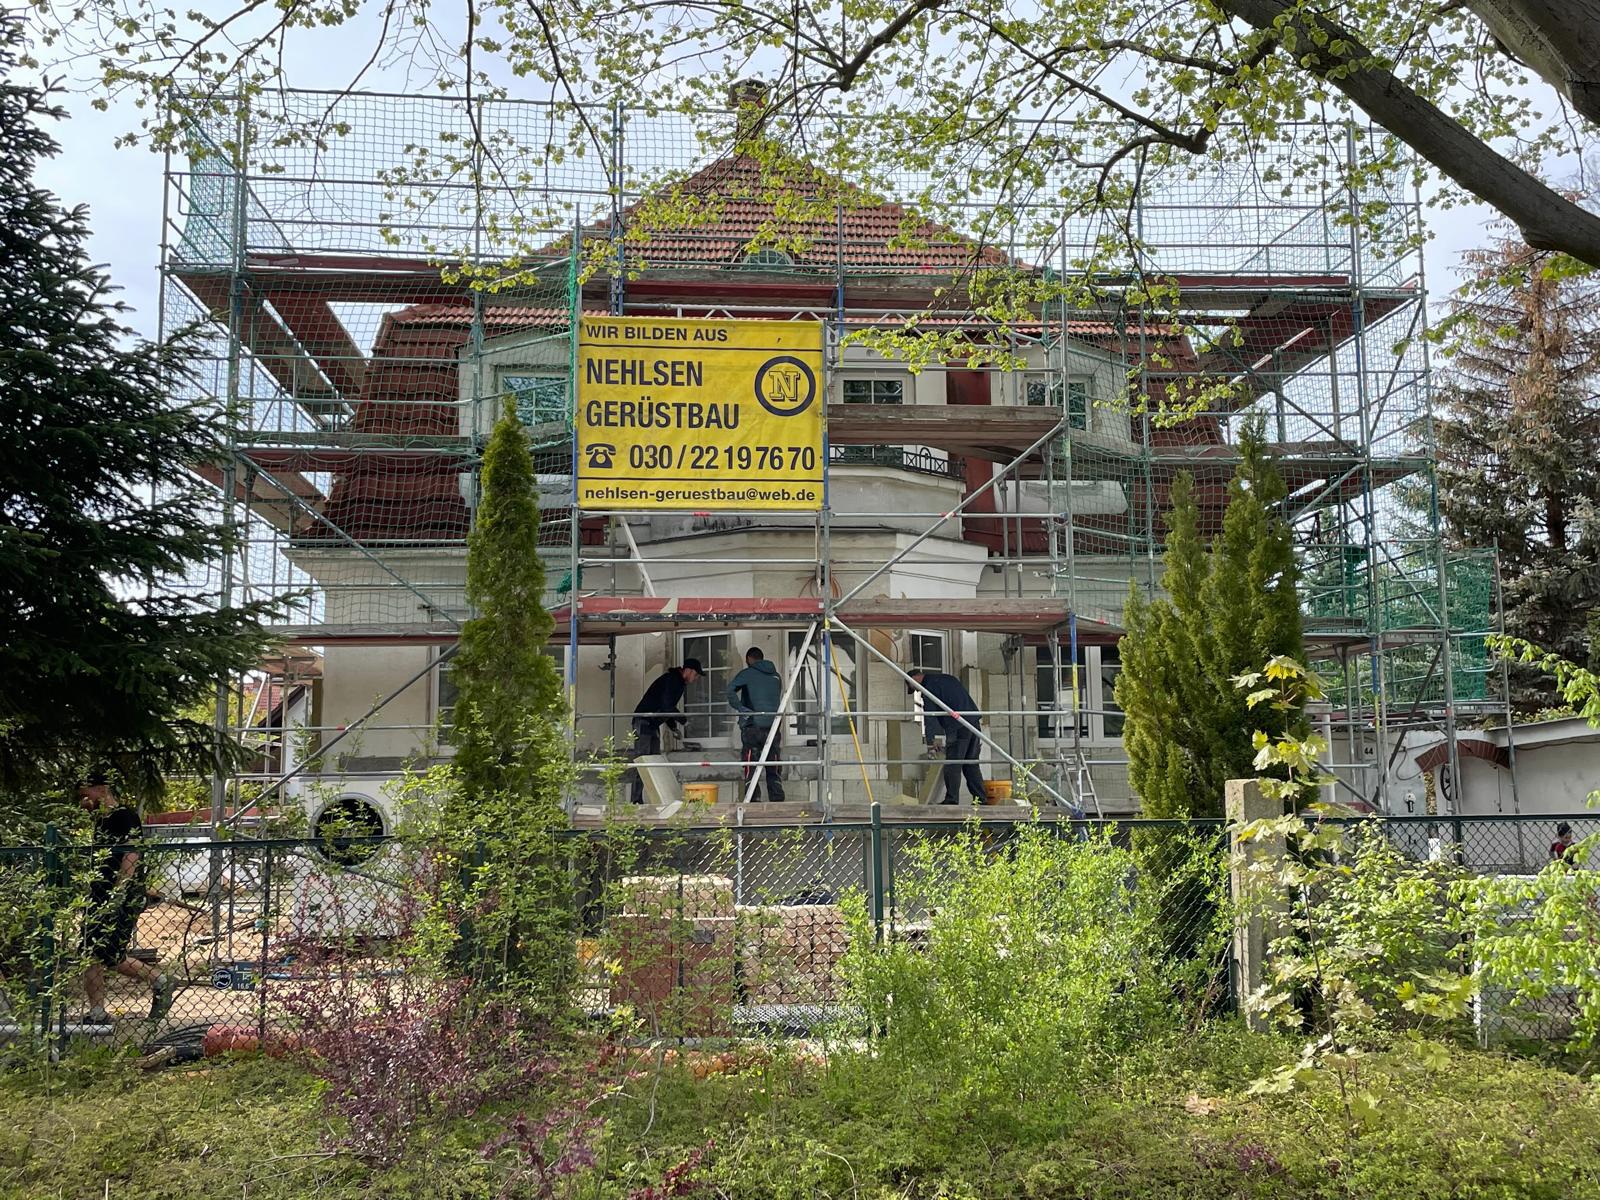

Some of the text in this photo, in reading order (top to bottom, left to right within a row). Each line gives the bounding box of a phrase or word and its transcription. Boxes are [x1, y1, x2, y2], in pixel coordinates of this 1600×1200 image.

[585, 325, 728, 342] WIR BILDEN AUS
[586, 358, 703, 387] NEHLSEN
[768, 371, 801, 402] N
[586, 396, 740, 429] GERÜSTBAU
[585, 487, 816, 503] nehlsen-geruestbau@web.de
[1364, 747, 1374, 755] 44
